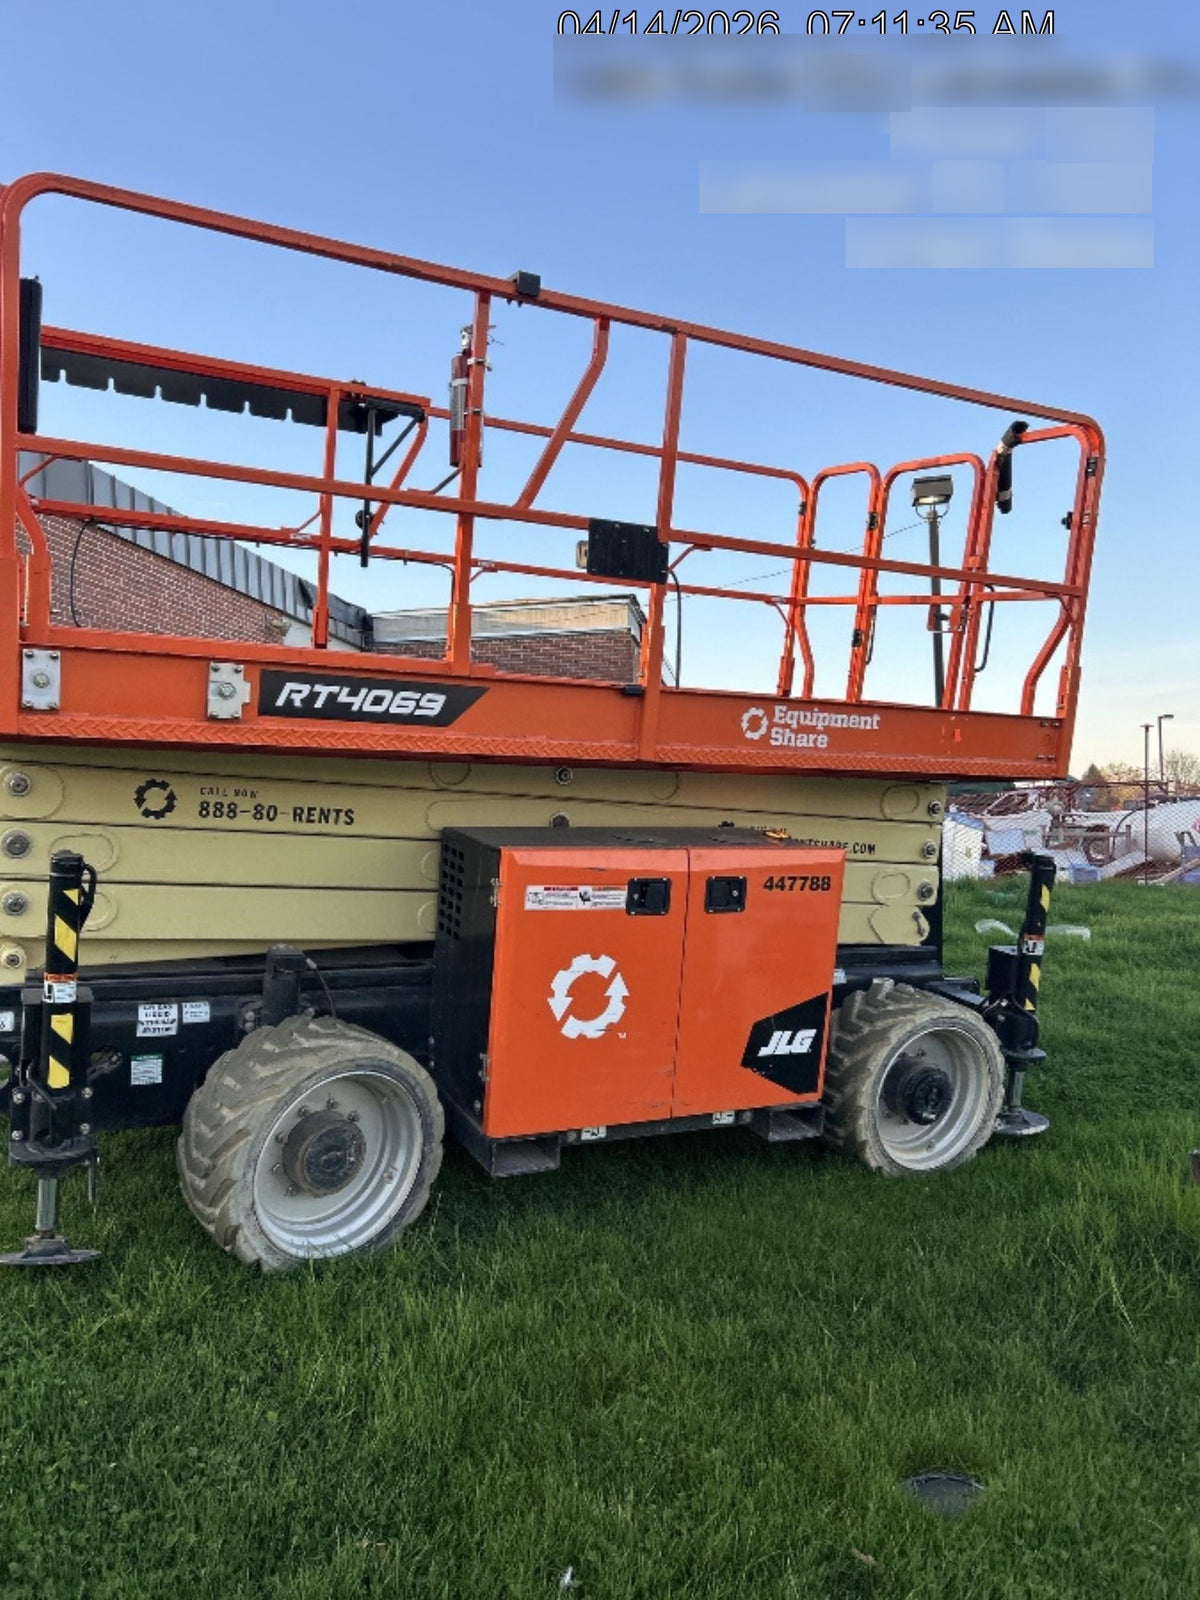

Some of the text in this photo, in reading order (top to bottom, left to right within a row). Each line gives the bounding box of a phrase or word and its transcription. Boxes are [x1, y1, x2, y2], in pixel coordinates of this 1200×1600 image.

[275, 682, 447, 717] RT4069
[773, 705, 880, 731] Equipment
[769, 726, 829, 748] Share
[200, 787, 228, 798] CALL
[198, 800, 355, 826] 888-80-RENTS
[763, 875, 832, 893] 447788
[757, 1029, 817, 1056] JLG
